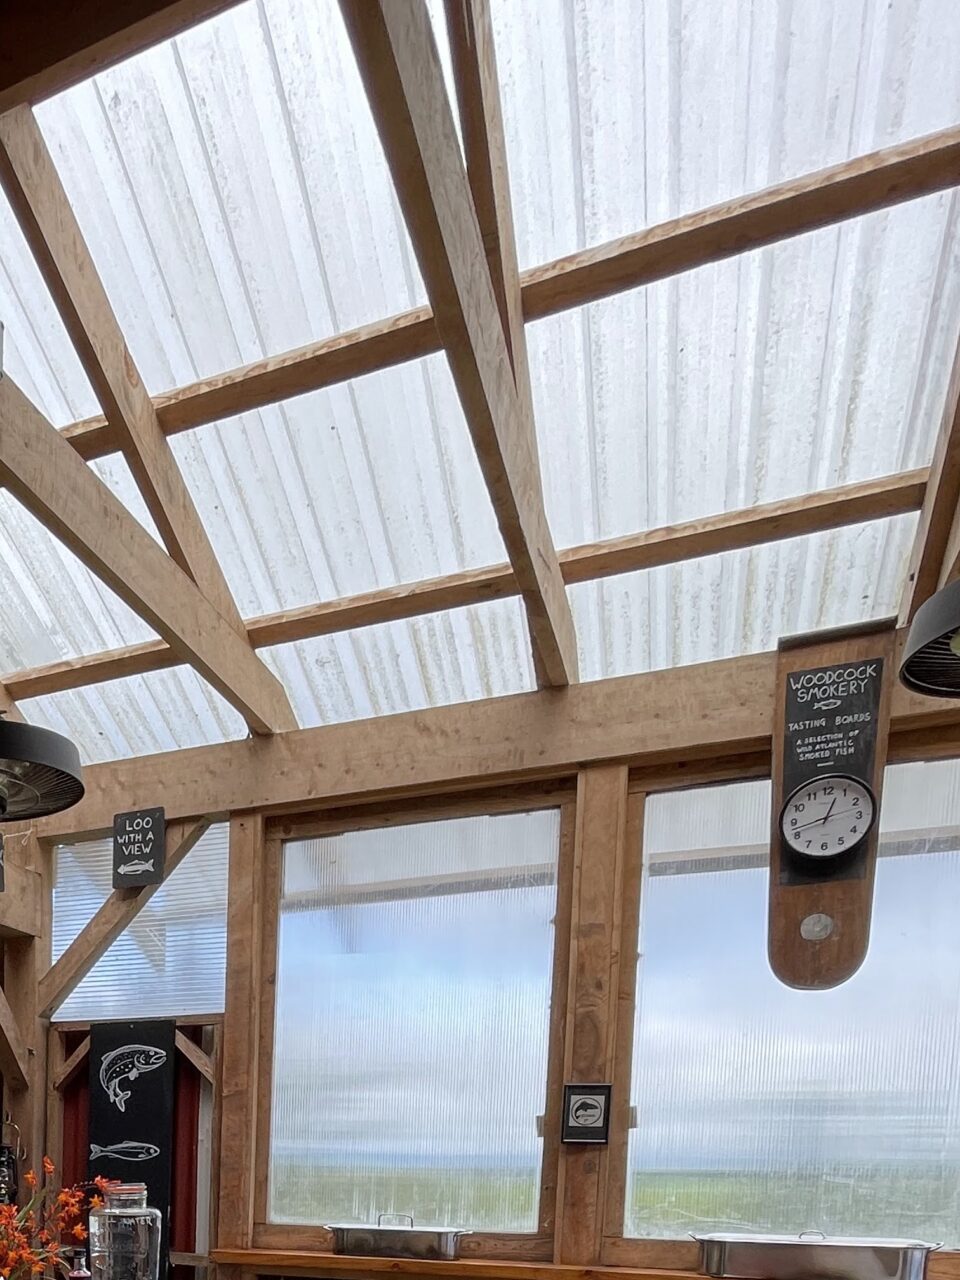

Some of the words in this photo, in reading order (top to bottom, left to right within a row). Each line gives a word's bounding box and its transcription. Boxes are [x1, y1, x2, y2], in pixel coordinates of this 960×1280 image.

[790, 664, 877, 690] WOODCOCK
[797, 679, 868, 702] SMOKERY
[788, 718, 826, 731] TASTING
[835, 712, 871, 725] BOARDS
[804, 733, 843, 744] SELECTION
[815, 740, 854, 750] ATLANTIC
[799, 750, 830, 761] SMOKED
[836, 747, 855, 756] FISH
[822, 786, 834, 796] 12
[843, 788, 847, 797] 1
[807, 792, 817, 801] 11
[852, 797, 859, 806] 2
[793, 803, 805, 813] 10
[856, 811, 863, 820] 3
[125, 817, 152, 830] LOO
[791, 818, 797, 826] 9
[850, 825, 857, 833] 4
[117, 833, 142, 843] WITH
[146, 831, 154, 840] A
[794, 831, 800, 840] 8
[805, 840, 812, 848] 7
[837, 837, 845, 845] 5
[122, 842, 152, 855] VIEW
[821, 842, 828, 851] 6
